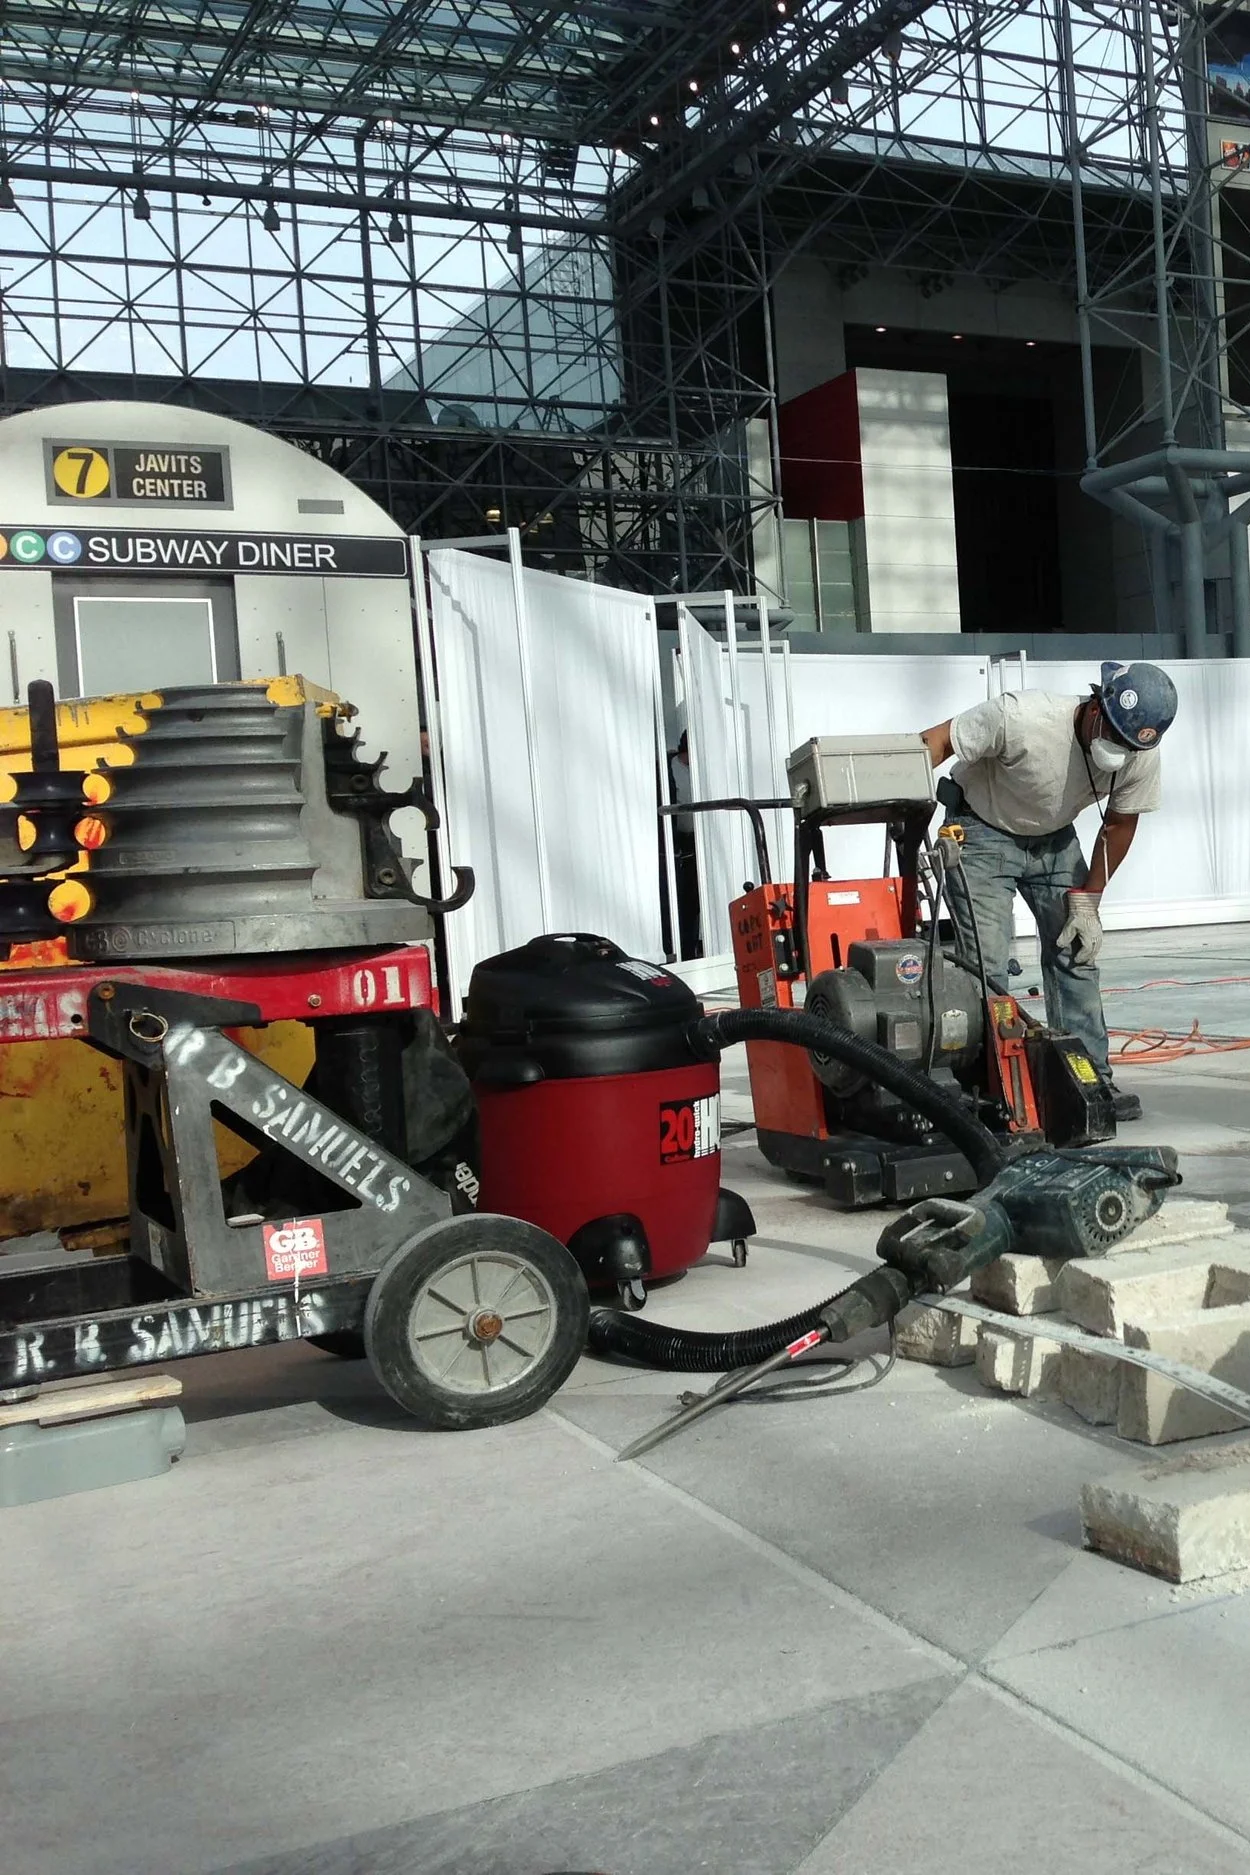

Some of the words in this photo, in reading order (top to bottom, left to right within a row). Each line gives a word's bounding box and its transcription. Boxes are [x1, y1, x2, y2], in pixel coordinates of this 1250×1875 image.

[67, 452, 94, 495] 7
[135, 453, 202, 475] JAVITS
[132, 478, 207, 499] CENTER
[88, 536, 229, 565] SUBWAY
[238, 542, 338, 568] DINER
[353, 965, 407, 1006] 01
[207, 1056, 246, 1090] B
[252, 1084, 411, 1215] SAMUELS
[660, 1106, 695, 1154] 20
[693, 1099, 702, 1159] hydro-quick
[269, 1226, 319, 1255] GB
